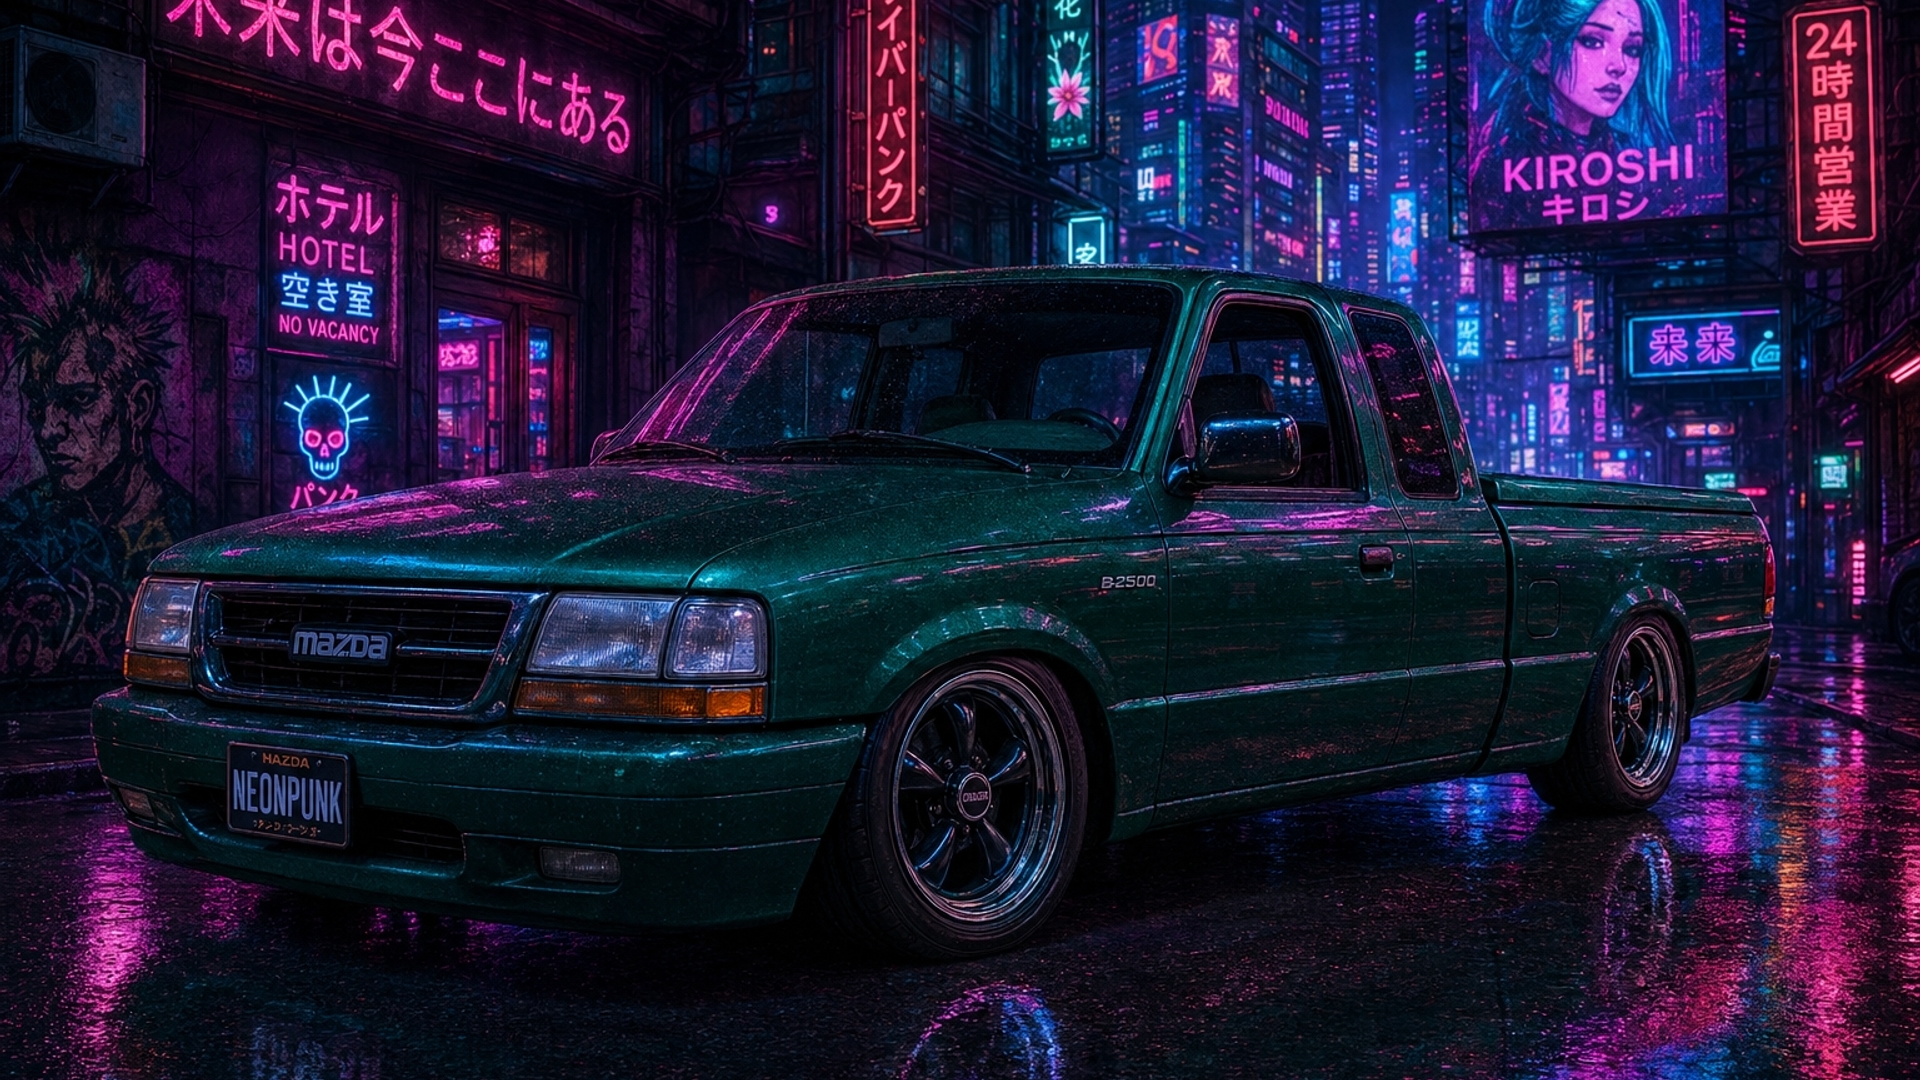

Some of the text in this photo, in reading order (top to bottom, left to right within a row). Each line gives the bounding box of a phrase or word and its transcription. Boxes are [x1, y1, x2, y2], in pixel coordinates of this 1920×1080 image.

[875, 0, 908, 213] イバーパンク
[1805, 19, 1858, 232] 24時間営業
[1504, 144, 1693, 193] KIROSHI
[275, 174, 384, 235] ホテル
[1542, 190, 1649, 225] キロシ
[279, 231, 374, 275] HOTEL
[281, 272, 374, 318] 空き室
[279, 314, 379, 345] NO VACANCY
[1101, 575, 1156, 589] B-2500
[233, 769, 342, 824] NEONPUNK
